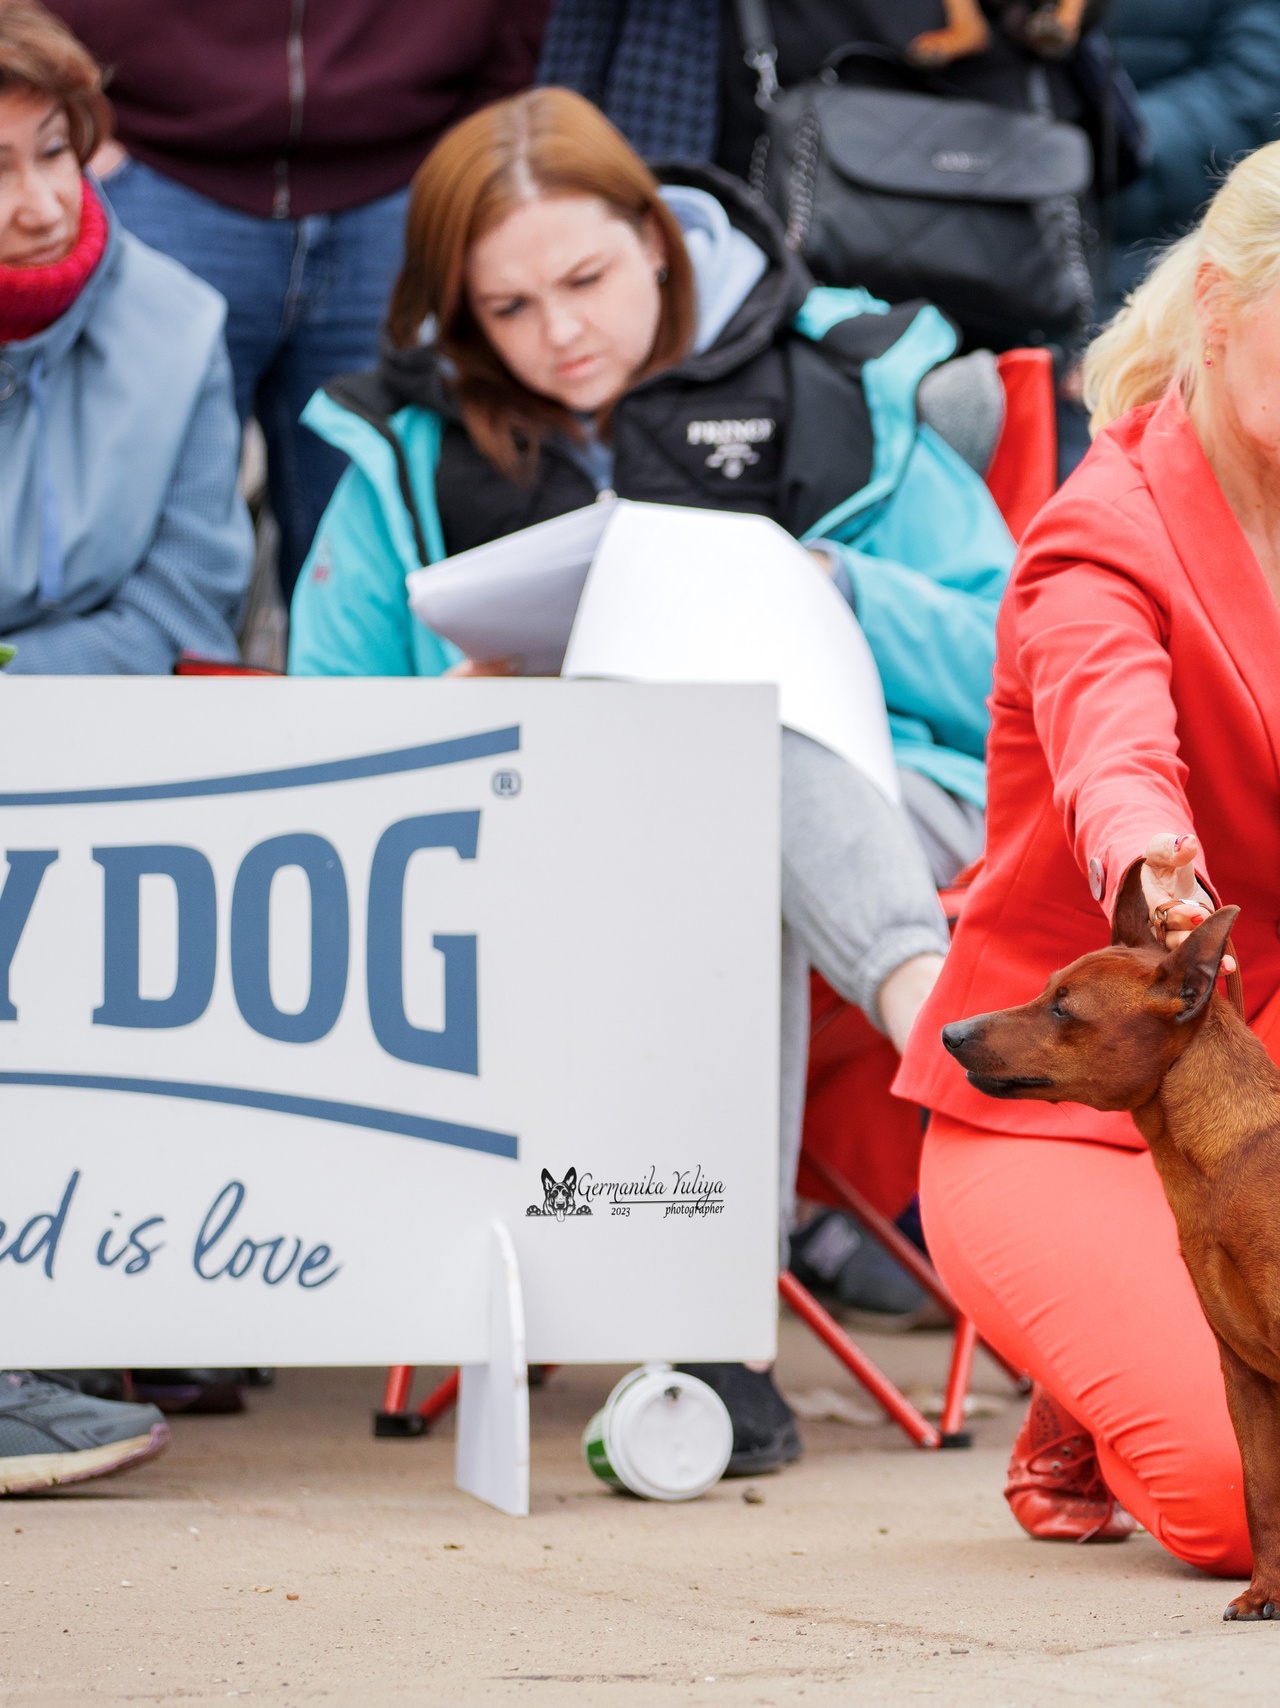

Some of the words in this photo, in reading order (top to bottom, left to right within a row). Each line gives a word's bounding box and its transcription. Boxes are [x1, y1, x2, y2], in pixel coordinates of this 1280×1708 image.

[92, 809, 482, 1077] DOG
[96, 1211, 166, 1276] is
[192, 1179, 341, 1290] love
